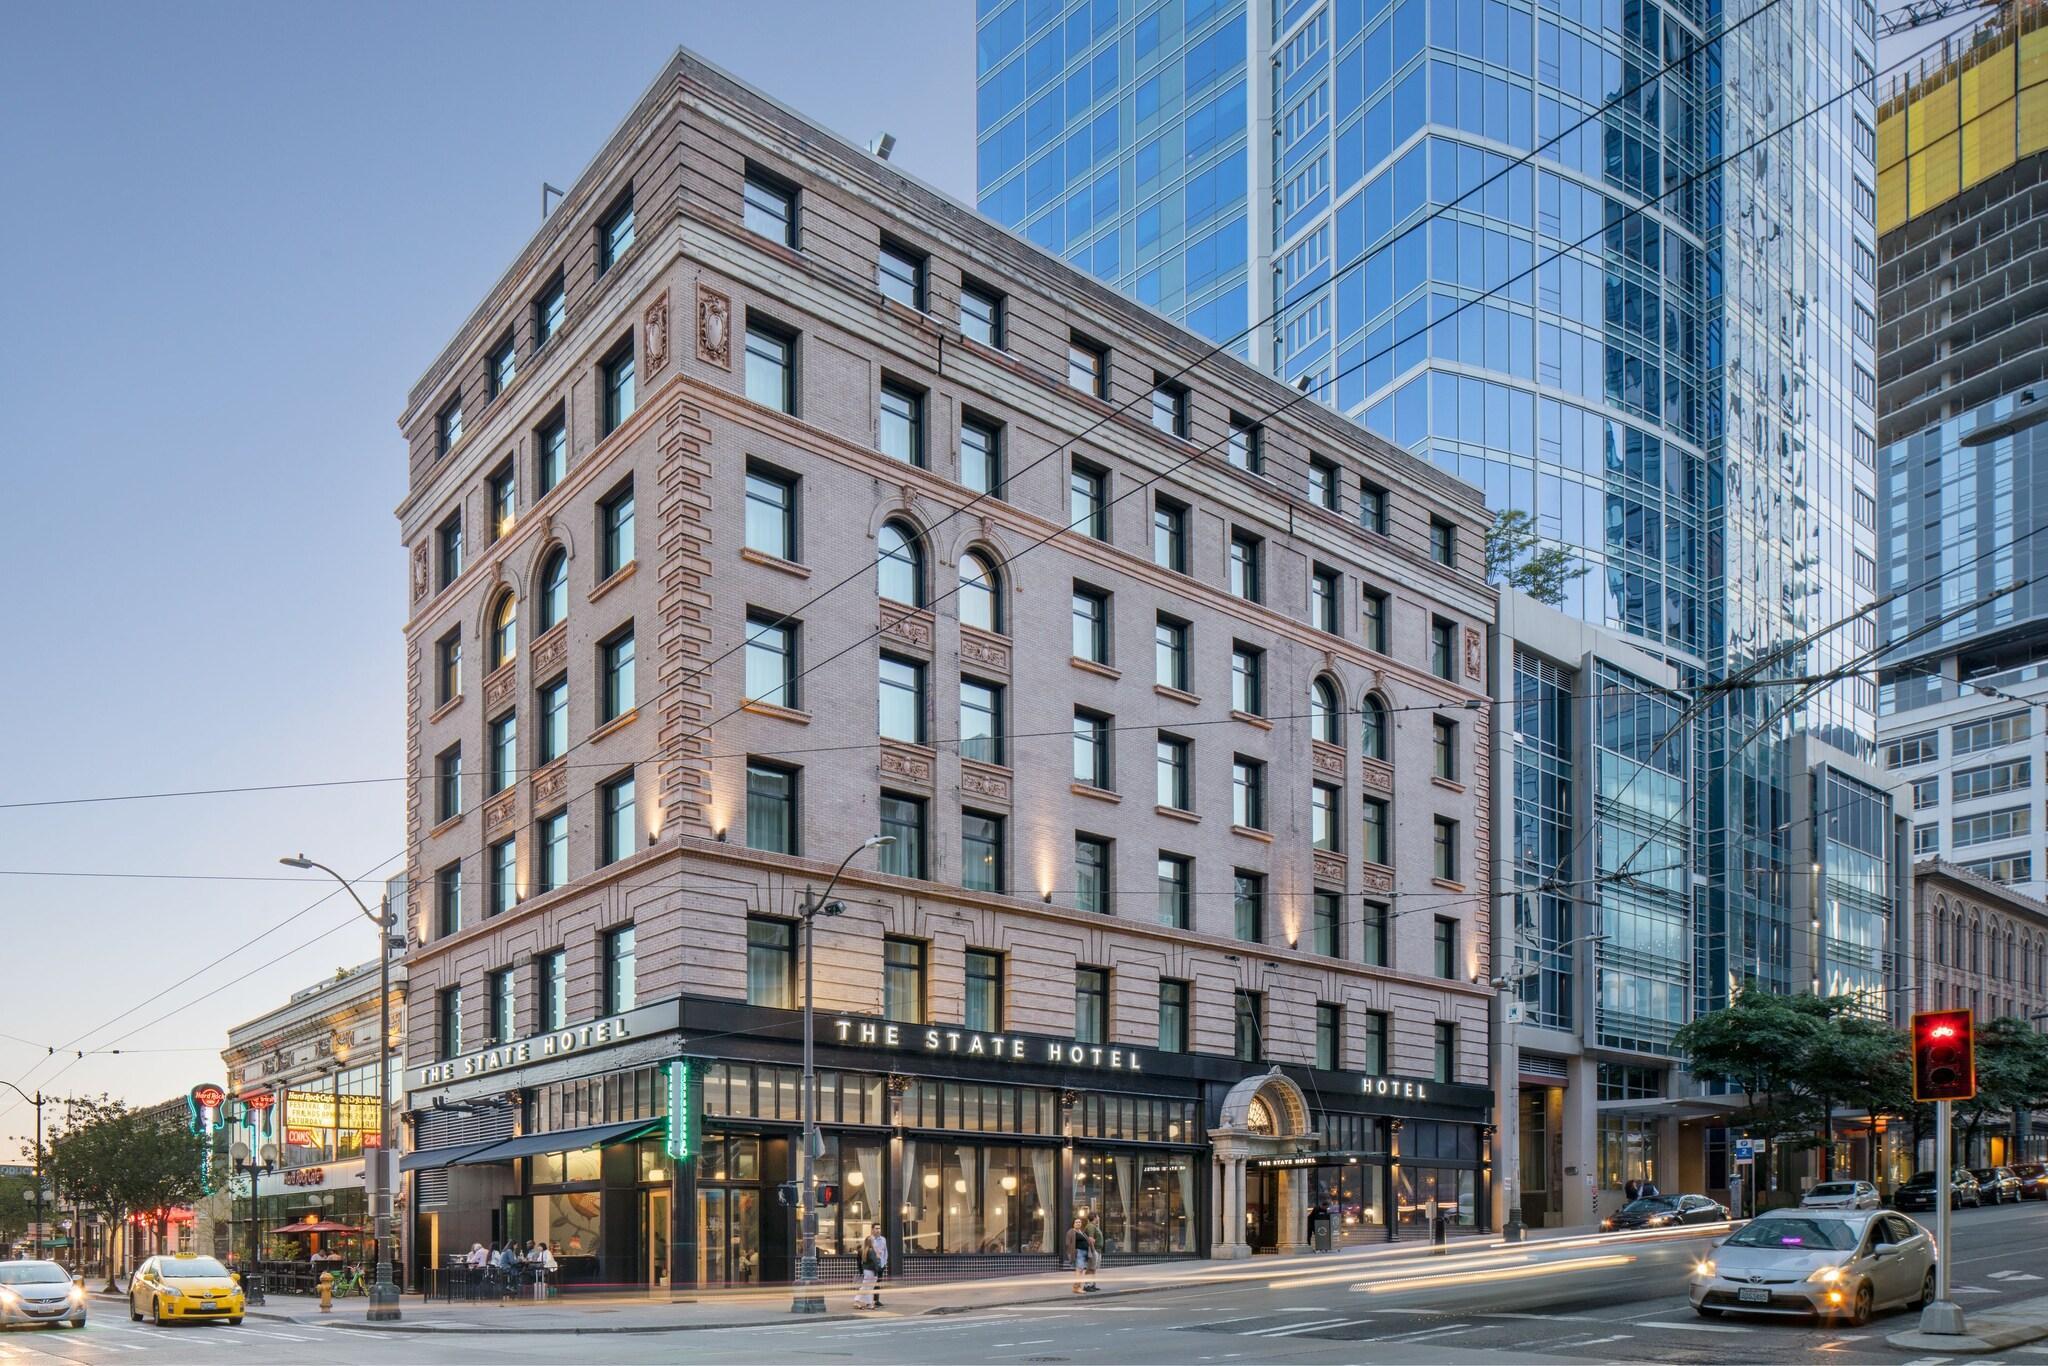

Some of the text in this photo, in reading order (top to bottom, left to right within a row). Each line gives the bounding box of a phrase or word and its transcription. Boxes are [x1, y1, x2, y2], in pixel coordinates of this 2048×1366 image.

[421, 1018, 630, 1084] THE STATE HOTEL
[835, 1020, 1141, 1069] THE STATE HOTEL
[1362, 1078, 1426, 1099] HOTEL
[288, 1091, 335, 1104] Hard Rock Cafe
[288, 1117, 322, 1125] SATURDAY
[289, 1131, 310, 1141] COINS
